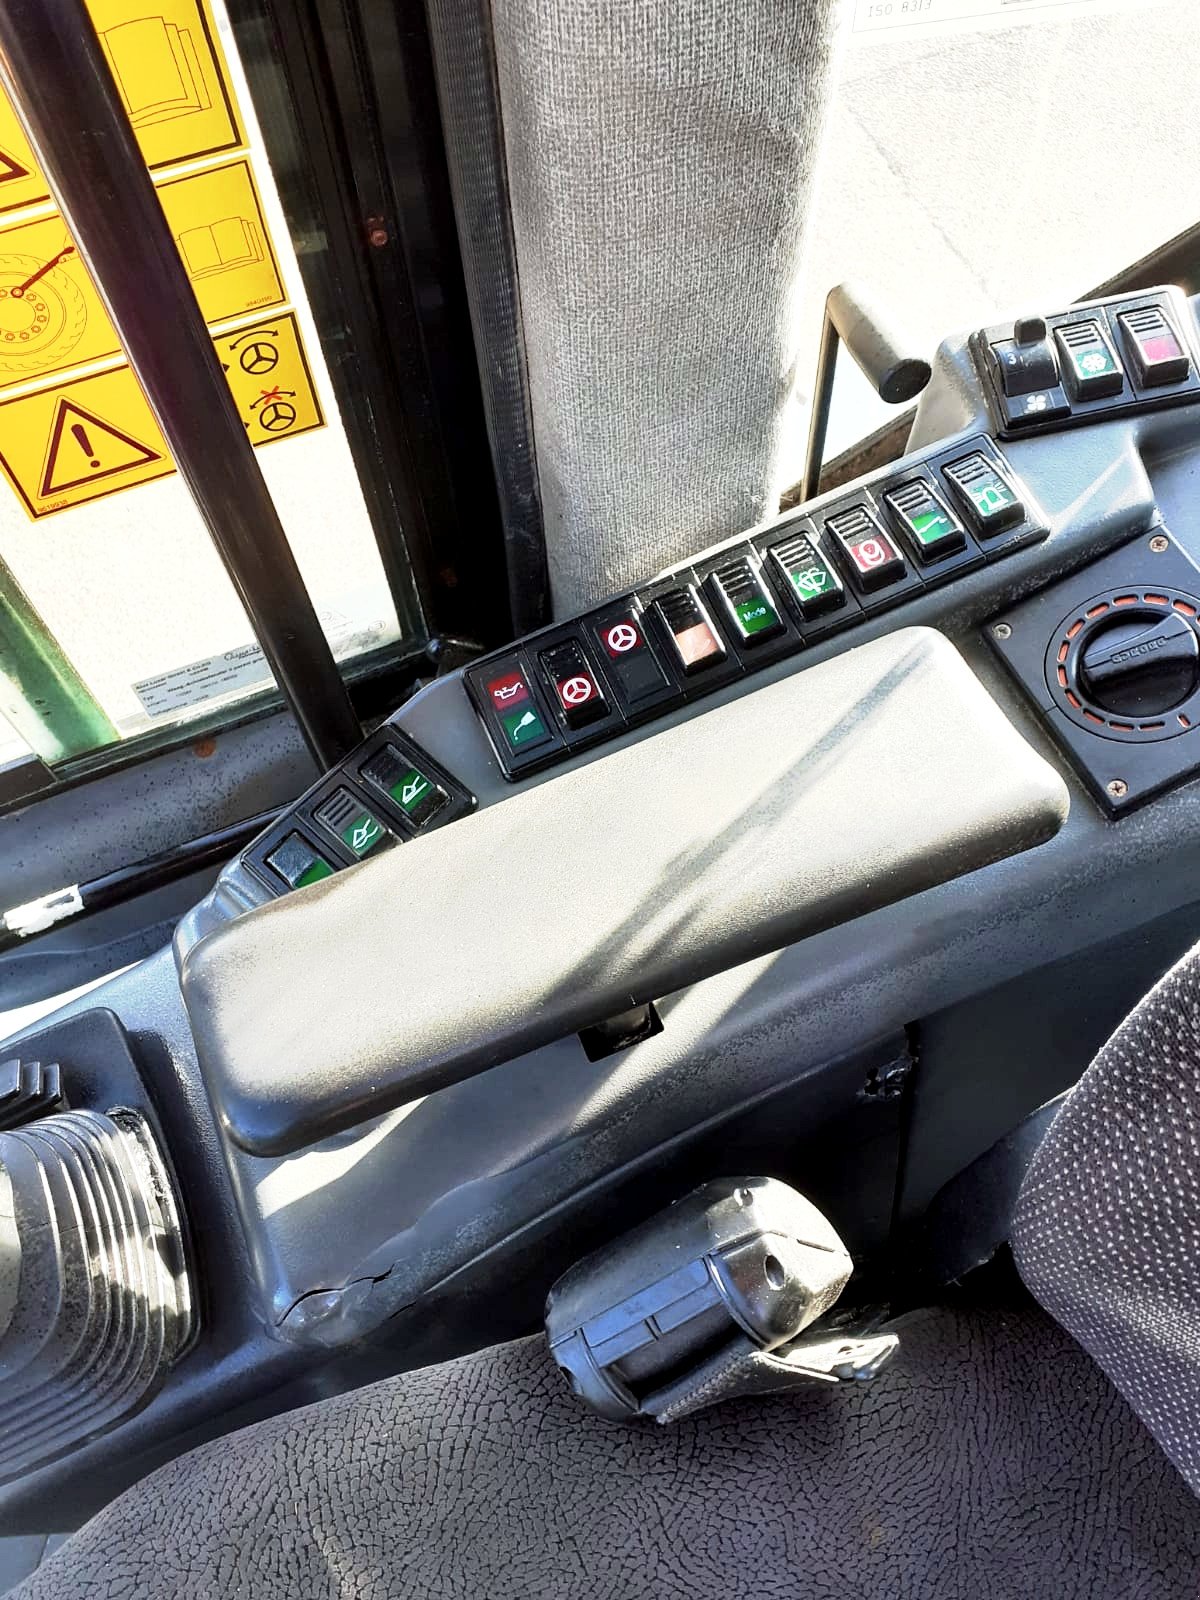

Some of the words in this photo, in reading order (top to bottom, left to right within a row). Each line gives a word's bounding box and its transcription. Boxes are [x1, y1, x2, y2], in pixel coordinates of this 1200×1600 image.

[867, 3, 893, 18] ISO
[1007, 352, 1017, 365] 3
[743, 607, 767, 622] Mode
